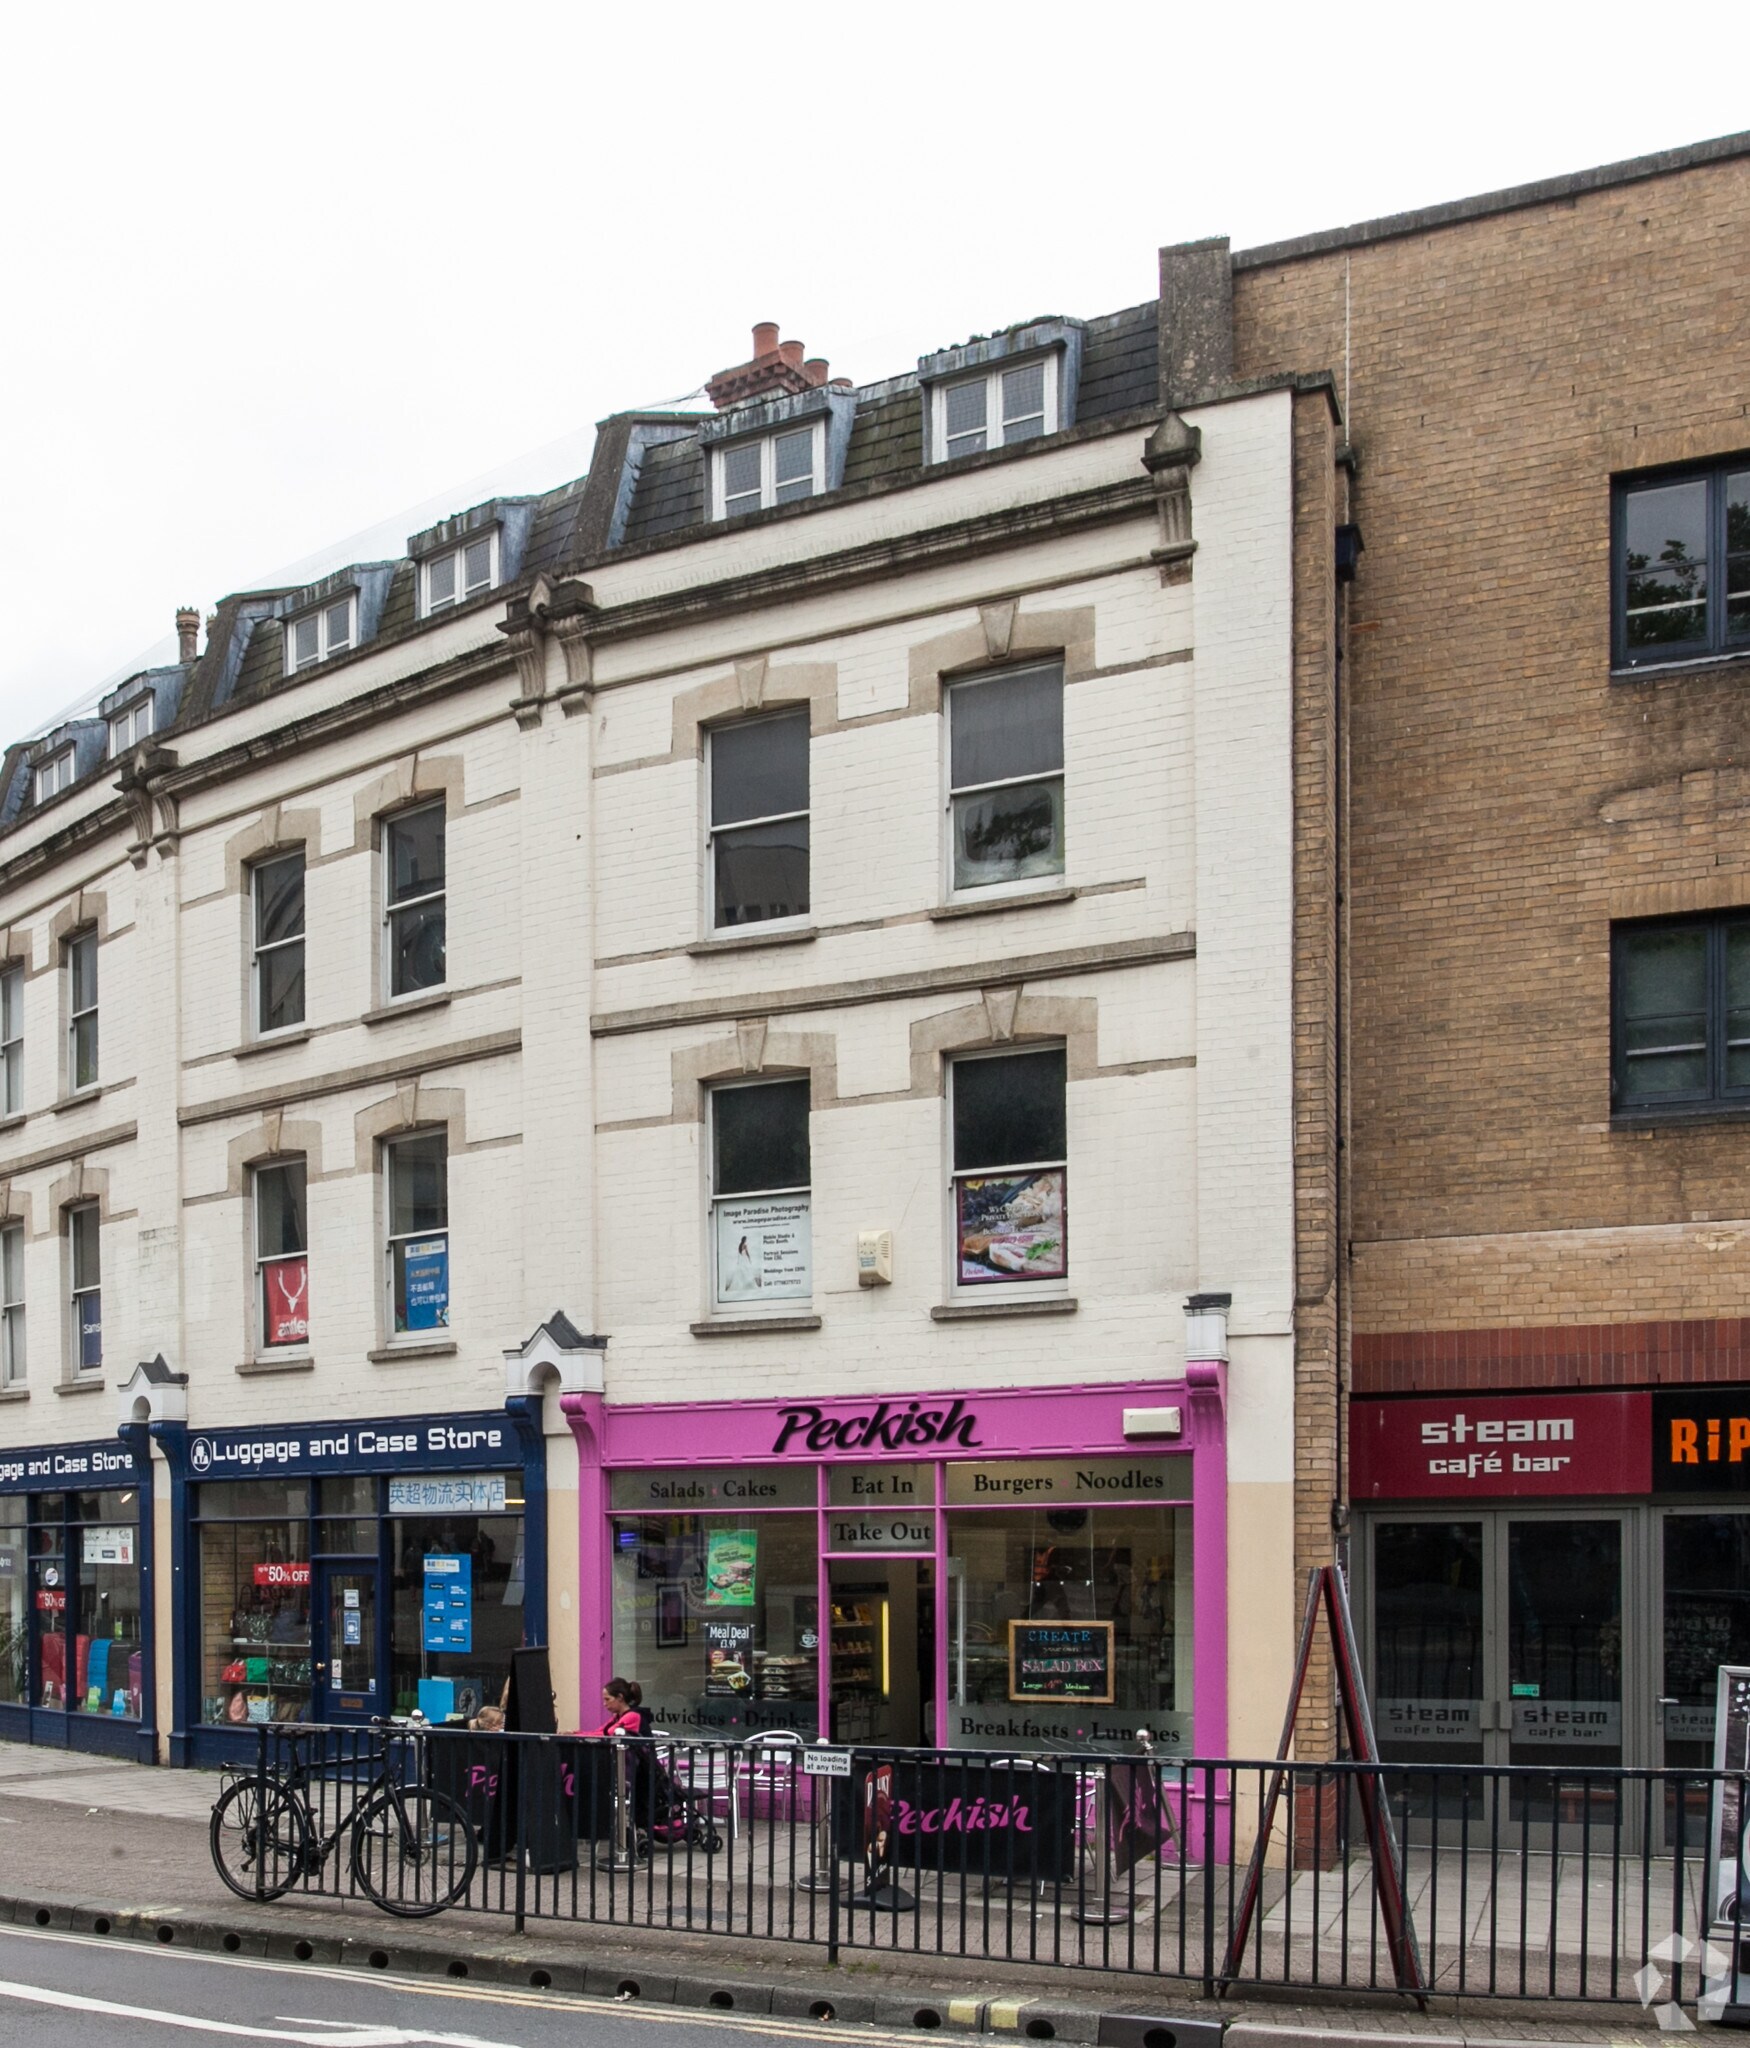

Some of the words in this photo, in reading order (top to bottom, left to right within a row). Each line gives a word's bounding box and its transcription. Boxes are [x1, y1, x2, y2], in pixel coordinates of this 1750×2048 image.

[723, 1210, 741, 1218] Image
[743, 1207, 769, 1216] Paradise
[770, 1204, 809, 1213] Photography
[772, 1399, 983, 1453] Peckish
[1421, 1414, 1574, 1444] steam
[212, 1440, 300, 1465] Luggage
[309, 1433, 349, 1456] and
[358, 1432, 417, 1454] Case
[428, 1427, 502, 1450] Store
[28, 1456, 50, 1476] and
[55, 1455, 88, 1474] Case
[92, 1452, 133, 1472] Store
[1429, 1451, 1502, 1478] café
[1513, 1453, 1570, 1472] bar
[650, 1482, 705, 1498] Salads
[723, 1480, 777, 1497] Cakes
[852, 1476, 884, 1494] Eat
[891, 1475, 914, 1493] In
[974, 1474, 1053, 1495] Burgers
[1076, 1470, 1164, 1490] Noodles
[389, 1479, 504, 1505] 英超物流实体店
[835, 1523, 882, 1541] Take
[890, 1522, 931, 1541] Out
[292, 1570, 310, 1582] OFF
[709, 1625, 730, 1638] Meal
[731, 1626, 749, 1639] Deal
[1028, 1630, 1091, 1643] CREATE
[720, 1639, 737, 1648] £3.99
[1022, 1660, 1071, 1674] SALAD
[1074, 1659, 1105, 1673] BOX
[744, 1709, 809, 1729] Drinks
[1389, 1704, 1470, 1722] steam
[1523, 1706, 1608, 1725] steam
[960, 1717, 1069, 1739] Breakfasts
[1092, 1721, 1180, 1743] Lunhes
[1436, 1725, 1465, 1735] bar
[1573, 1728, 1603, 1738] bar
[820, 1754, 848, 1764] loading
[831, 1764, 848, 1772] time
